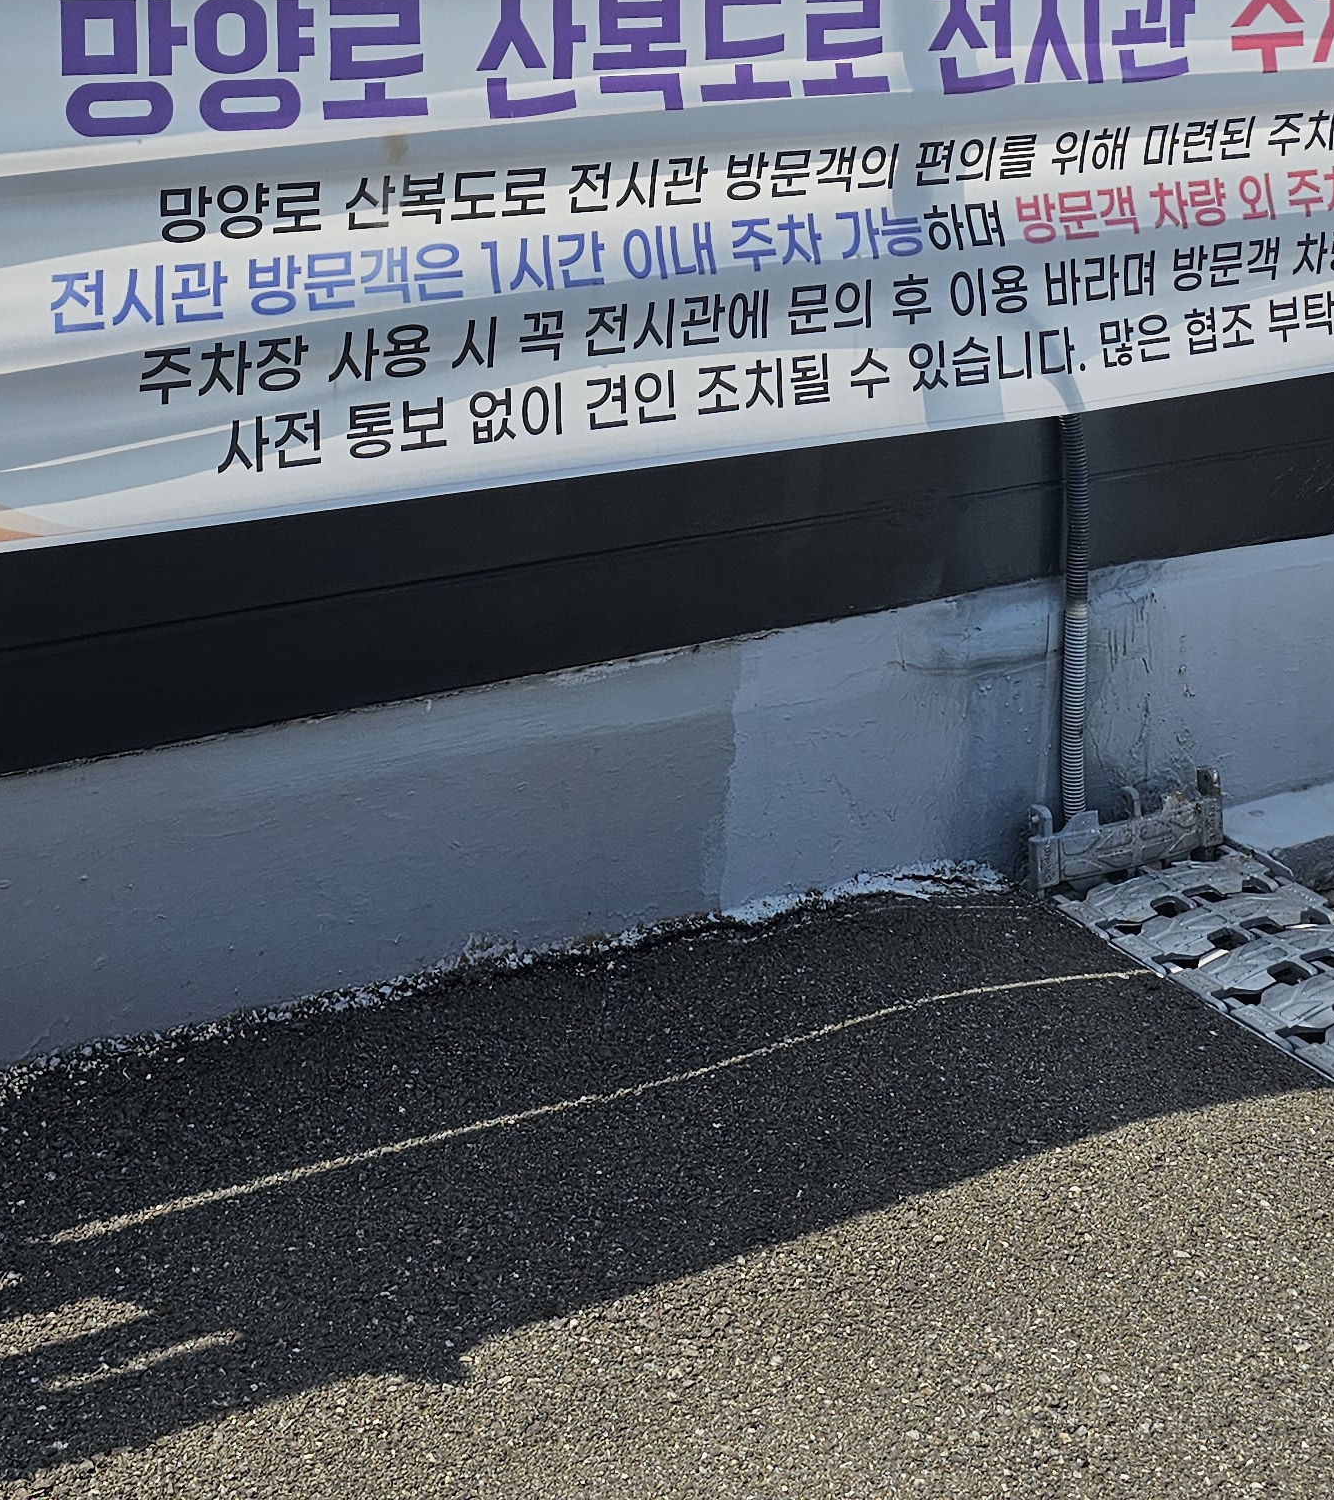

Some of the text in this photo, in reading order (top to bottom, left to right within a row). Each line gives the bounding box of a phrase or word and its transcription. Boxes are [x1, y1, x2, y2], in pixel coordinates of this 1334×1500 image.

[49, 260, 228, 334] 전시관
[246, 245, 464, 322] 방문객은
[482, 231, 605, 296] 1시간
[623, 218, 720, 284] 이내
[731, 211, 823, 272] 주차
[834, 200, 1010, 265] 가능하며
[1015, 188, 1140, 246] 방문객
[1149, 177, 1226, 233] 차량
[1238, 171, 1276, 222] 외
[159, 180, 323, 243] 망양로
[344, 166, 548, 231] 산복도로
[566, 154, 709, 213] 전시관
[725, 141, 898, 200] 방문객의
[914, 131, 1039, 189] 편의를
[1050, 125, 1131, 175] 위해
[1143, 114, 1256, 169] 마련된
[139, 335, 309, 406] 주차장
[328, 323, 431, 384] 사용
[452, 315, 498, 368] 시
[517, 307, 565, 363] 꼭
[584, 282, 769, 356] 전시관에
[787, 272, 873, 336] 문의
[892, 272, 931, 326] 후
[949, 261, 1026, 317] 이용
[1044, 247, 1157, 310] 바라며
[1171, 234, 1280, 291] 방문객
[218, 407, 323, 478] 사전
[344, 396, 449, 460] 통보
[468, 380, 565, 448] 없이
[583, 364, 677, 429] 견인
[696, 348, 831, 418] 조치될
[849, 347, 891, 401] 수
[907, 326, 1086, 393] 있습니다.
[1098, 313, 1170, 369] 많은
[1184, 302, 1257, 359] 협조
